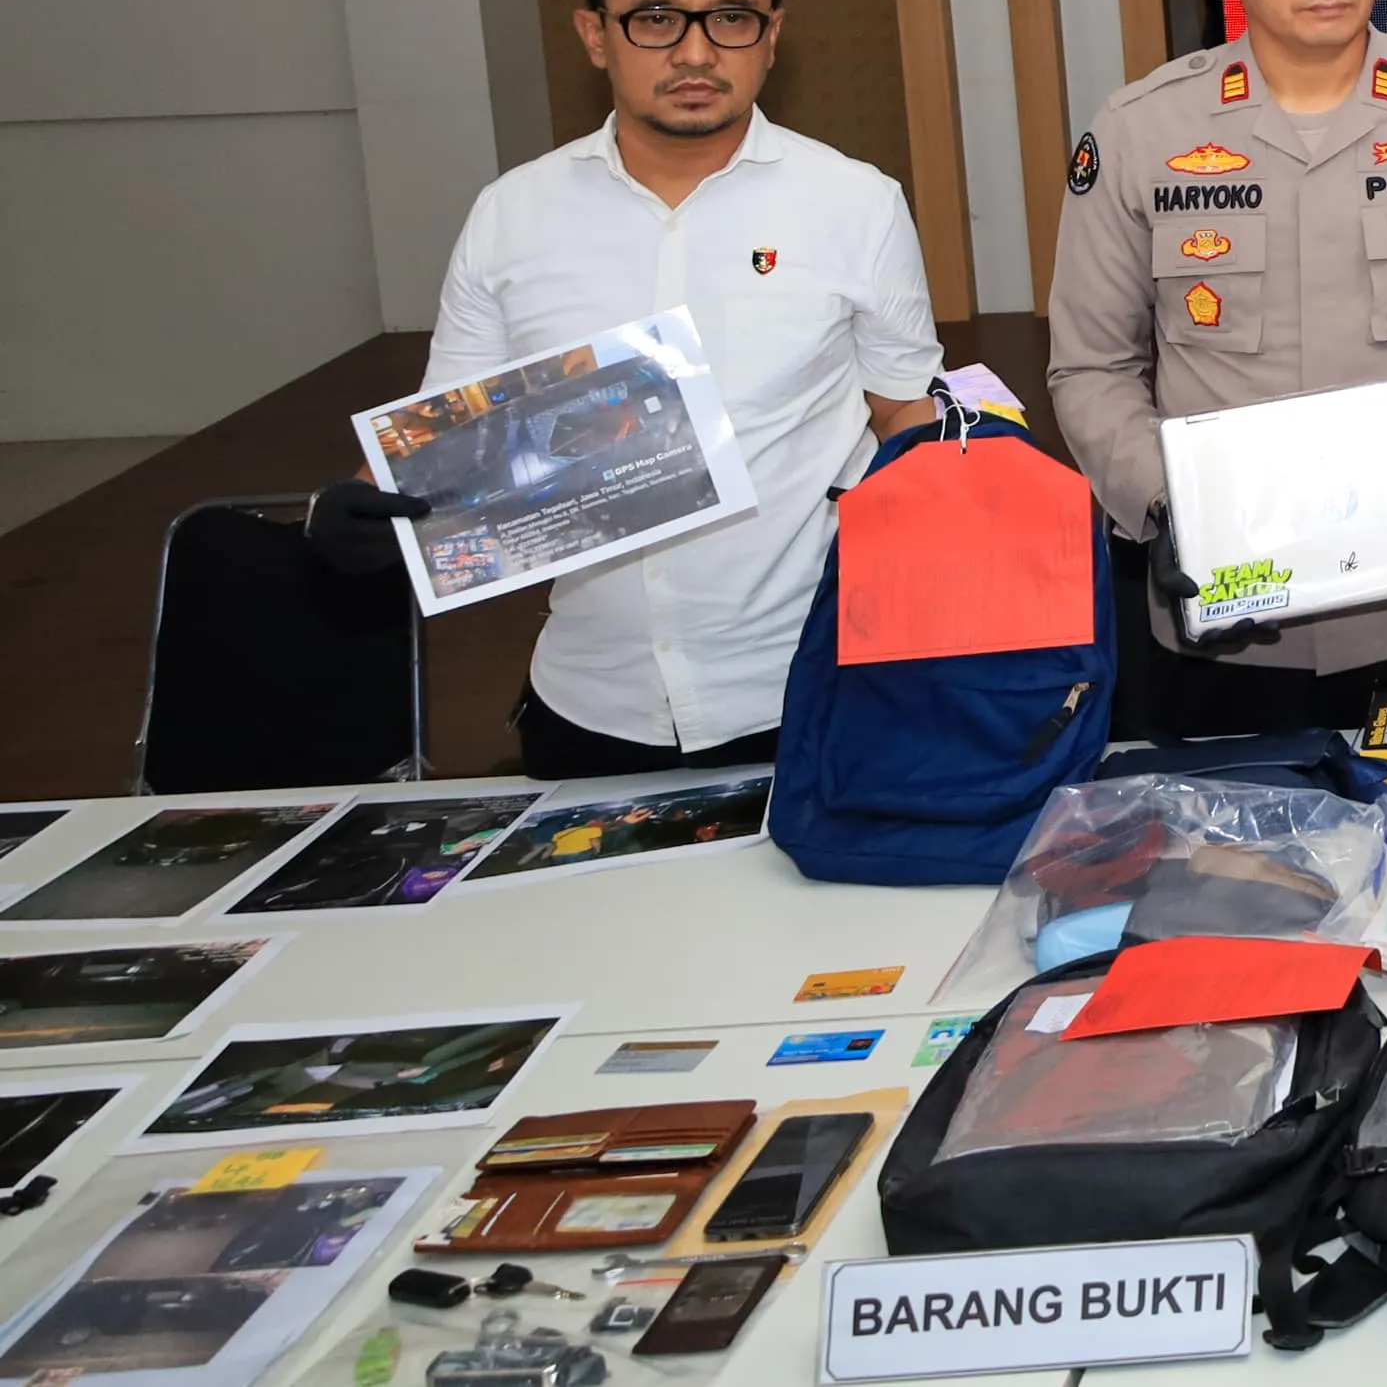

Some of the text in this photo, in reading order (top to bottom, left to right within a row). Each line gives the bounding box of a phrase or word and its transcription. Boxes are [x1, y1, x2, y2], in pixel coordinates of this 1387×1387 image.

[1154, 184, 1263, 213] HARYOKO
[615, 444, 692, 476] GPS Map Camera
[1211, 558, 1273, 585] TEAM
[851, 1272, 1226, 1337] BARANG BUKTI
